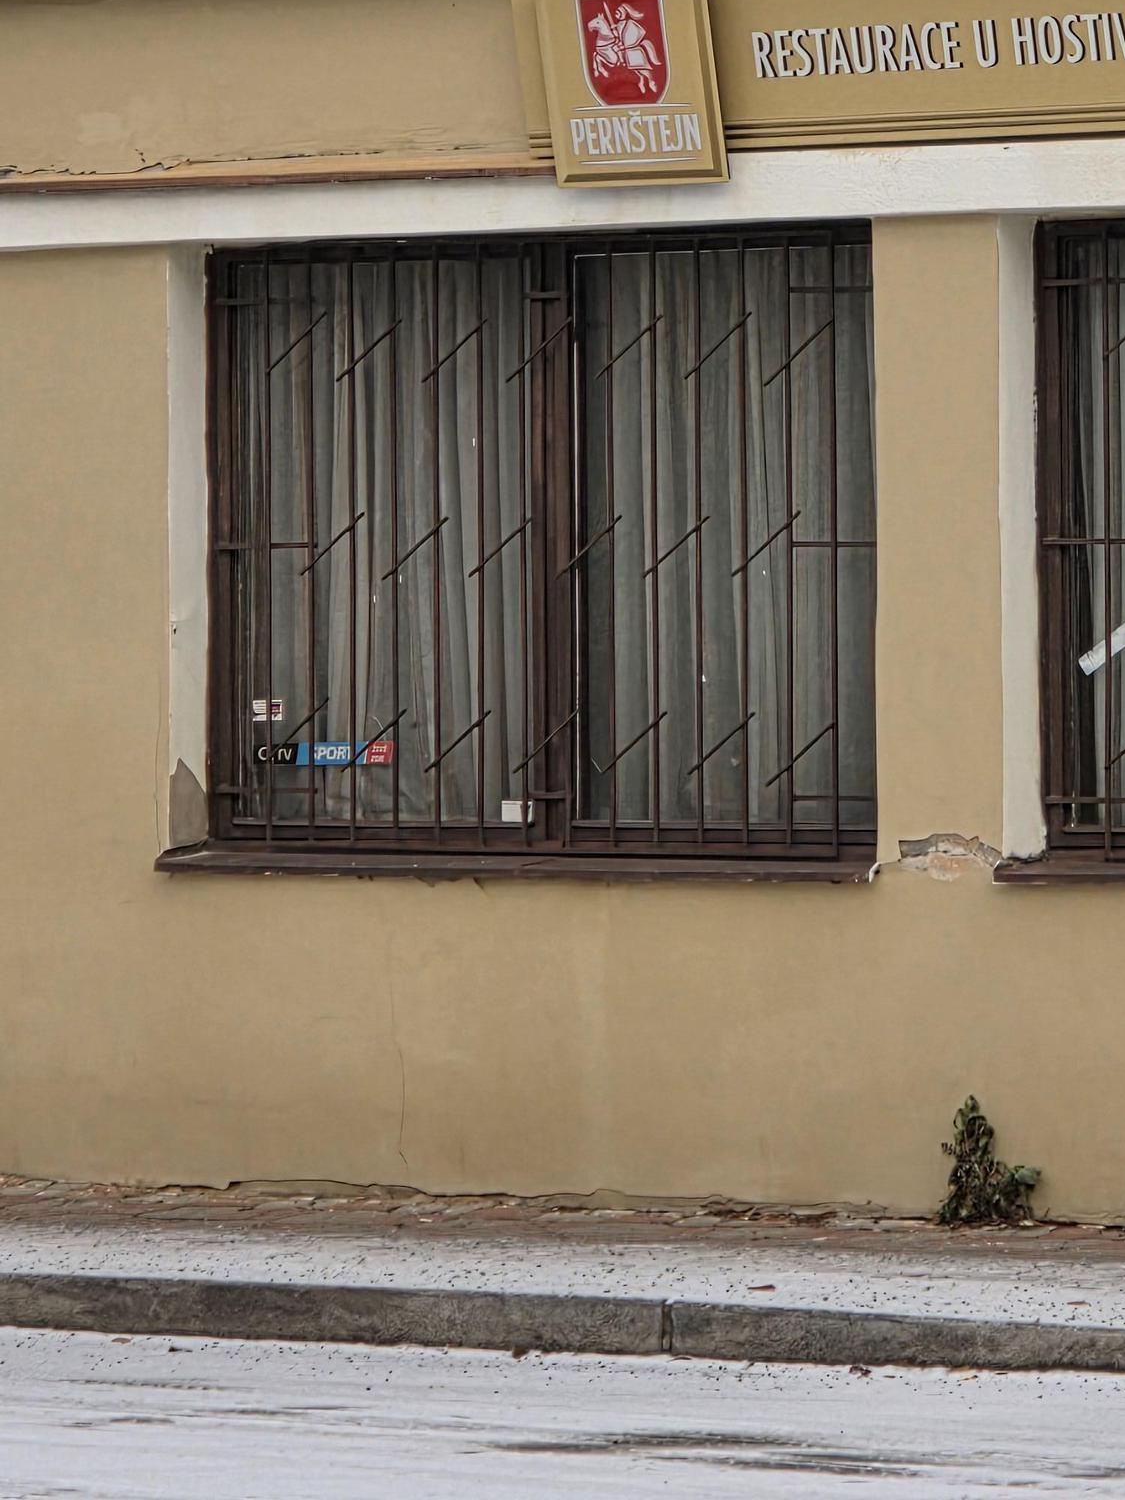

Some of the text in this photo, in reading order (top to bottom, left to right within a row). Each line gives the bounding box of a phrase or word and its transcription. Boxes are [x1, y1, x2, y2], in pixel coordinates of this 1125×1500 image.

[752, 21, 964, 79] RESTAURACE
[973, 18, 998, 68] U
[570, 111, 701, 156] PERNŠTEJN
